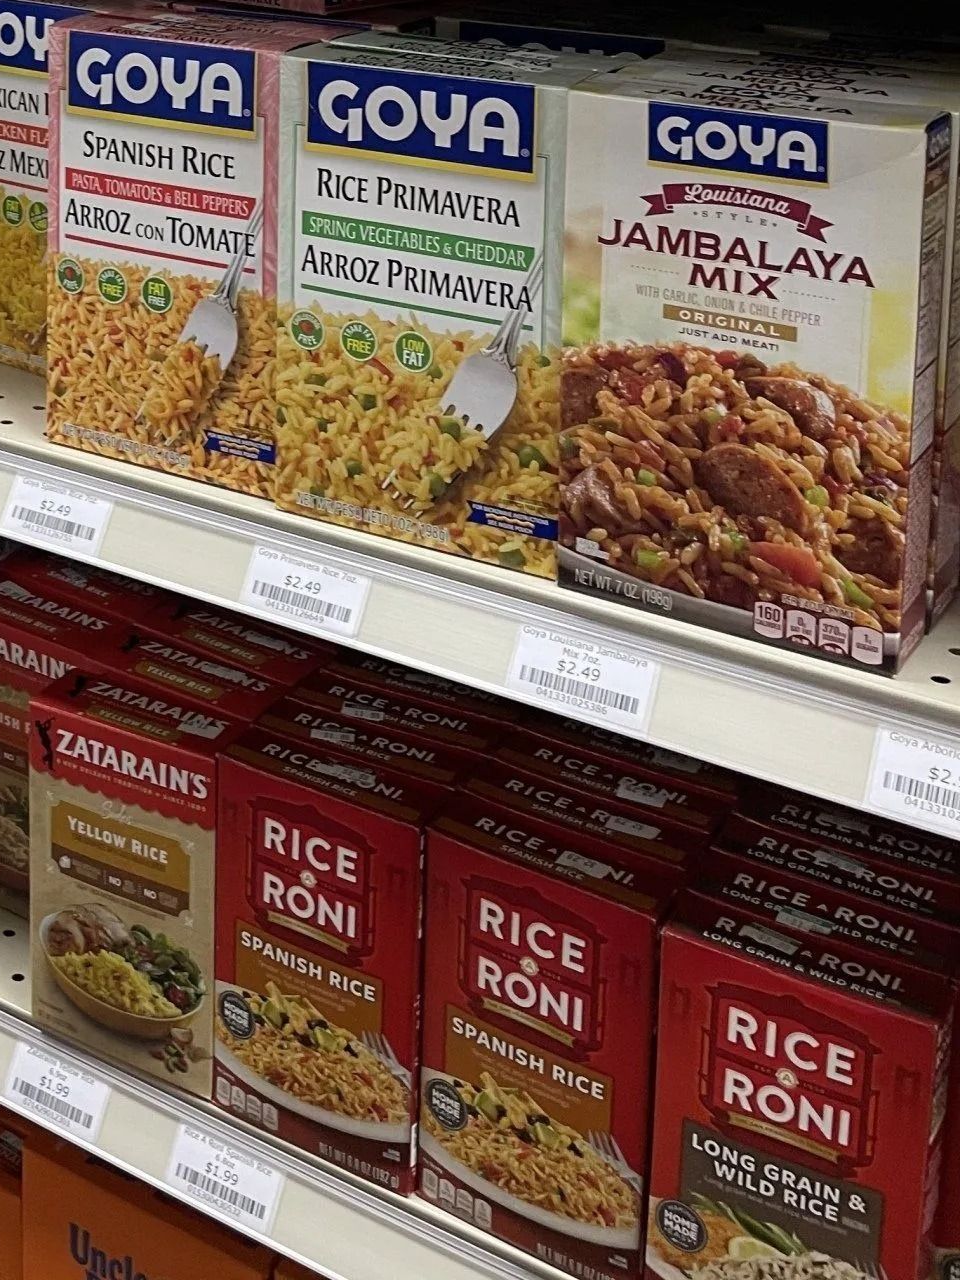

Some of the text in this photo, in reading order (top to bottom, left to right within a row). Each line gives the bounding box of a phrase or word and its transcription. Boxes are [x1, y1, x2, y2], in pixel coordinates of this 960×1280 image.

[76, 47, 243, 118] GOYA
[318, 78, 520, 158] GOYA
[656, 115, 817, 173] GOYA
[83, 130, 235, 180] SPANISH RICE
[317, 168, 520, 228] RICE PRIMAVERA
[683, 184, 791, 215] Louisiana
[65, 198, 256, 258] ARROZ CON TOMATE
[309, 216, 527, 268] SPRING VEGETABLES & CHEDDAR
[598, 218, 876, 288] JAMBALAYA
[301, 245, 534, 312] ARROZ PRIMAVERA
[688, 263, 781, 300] MIX
[401, 336, 425, 353] LOW
[678, 327, 780, 352] JUST ADD MEAT!
[679, 309, 781, 337] ORIGINAL
[402, 351, 425, 368] FAT
[40, 500, 72, 517] $2.49
[283, 575, 322, 595] $2.49
[757, 603, 781, 622] 160
[523, 625, 648, 668] Goya Louisiana Jambalaya
[556, 659, 601, 682] $2.49
[56, 728, 208, 800] ZATARAIN'S
[889, 731, 919, 747] Goya
[66, 815, 169, 865] YELLOW RICE
[264, 816, 358, 883] RICE
[262, 871, 357, 939] RONI
[479, 898, 586, 973] RICE
[241, 931, 376, 1003] SPANISH RICE
[477, 955, 584, 1032] RONI
[452, 1017, 605, 1101] SPANISH RICE
[727, 1006, 854, 1086] RICE
[39, 1076, 70, 1098] $1.99
[723, 1068, 849, 1147] RONI
[204, 1162, 239, 1186] $1.99
[692, 1132, 866, 1213] LONG GRAIN &
[714, 1160, 839, 1223] WILD RICE
